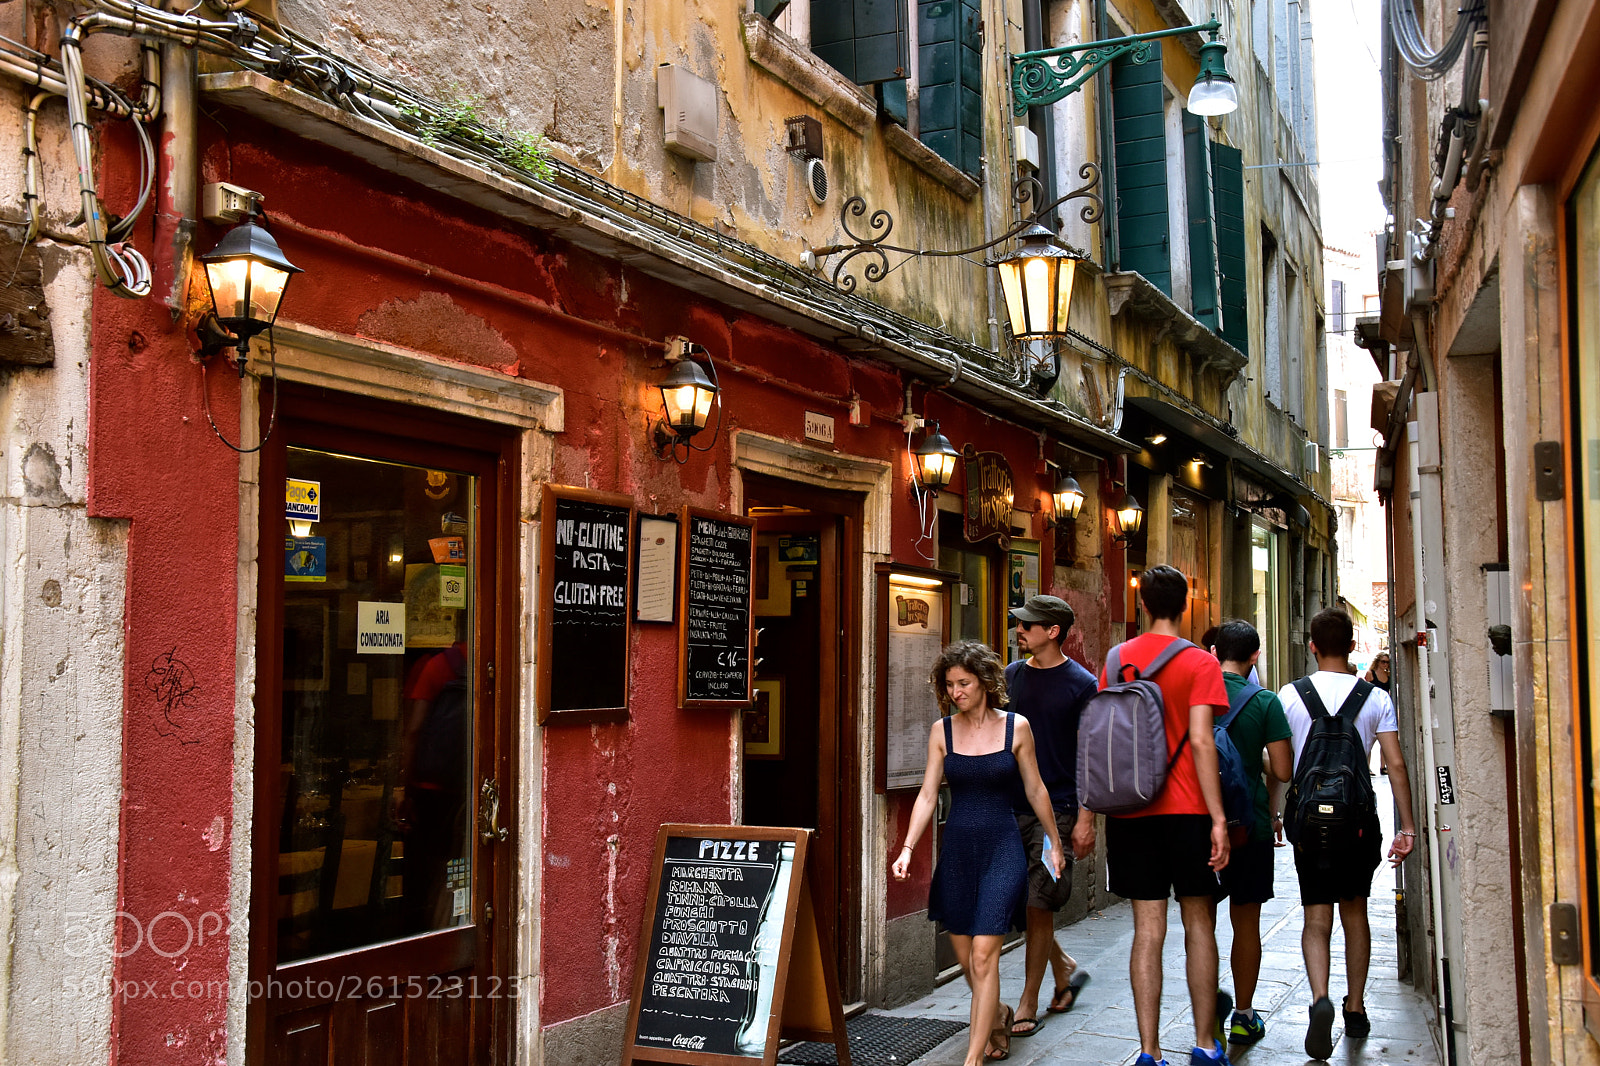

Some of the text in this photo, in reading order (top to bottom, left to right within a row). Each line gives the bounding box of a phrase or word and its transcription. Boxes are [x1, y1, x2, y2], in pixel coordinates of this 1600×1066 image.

[979, 457, 1012, 499] Trattoria
[572, 550, 610, 571] PASTA
[375, 609, 390, 625] ARIA
[360, 632, 404, 648] CONDIZIONATA
[1438, 766, 1453, 805] clarity
[698, 839, 760, 861] PIZZE
[671, 866, 744, 881] MARGHERITA
[669, 879, 724, 895] ROMANA
[664, 905, 715, 919] FUNGHI
[662, 918, 748, 936] PROSCIUTTO
[661, 931, 719, 948] DIAVOLA
[655, 957, 740, 976] CAPRICCIOSA
[651, 983, 731, 1003] PESCATORA
